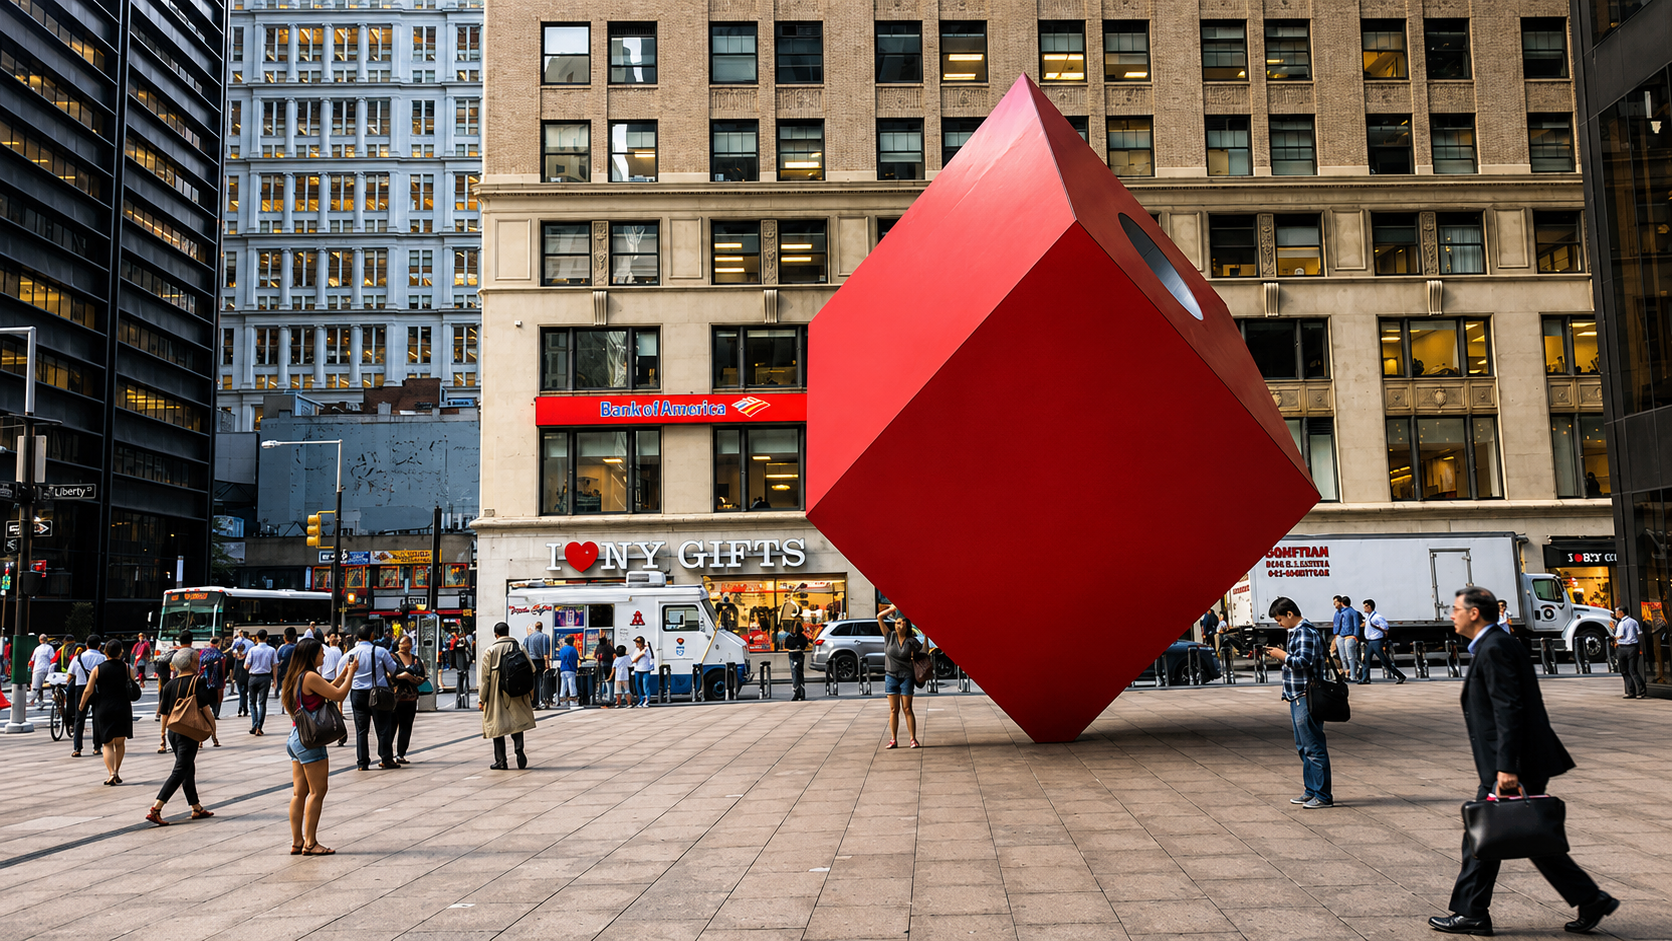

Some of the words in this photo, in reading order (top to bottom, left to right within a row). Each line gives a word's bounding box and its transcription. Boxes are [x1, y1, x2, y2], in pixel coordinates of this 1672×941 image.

[600, 401, 642, 417] Bank
[643, 400, 659, 417] of
[54, 487, 86, 498] Liberty
[546, 542, 562, 571] I
[601, 541, 666, 570] NY
[677, 538, 806, 569] GIFTS
